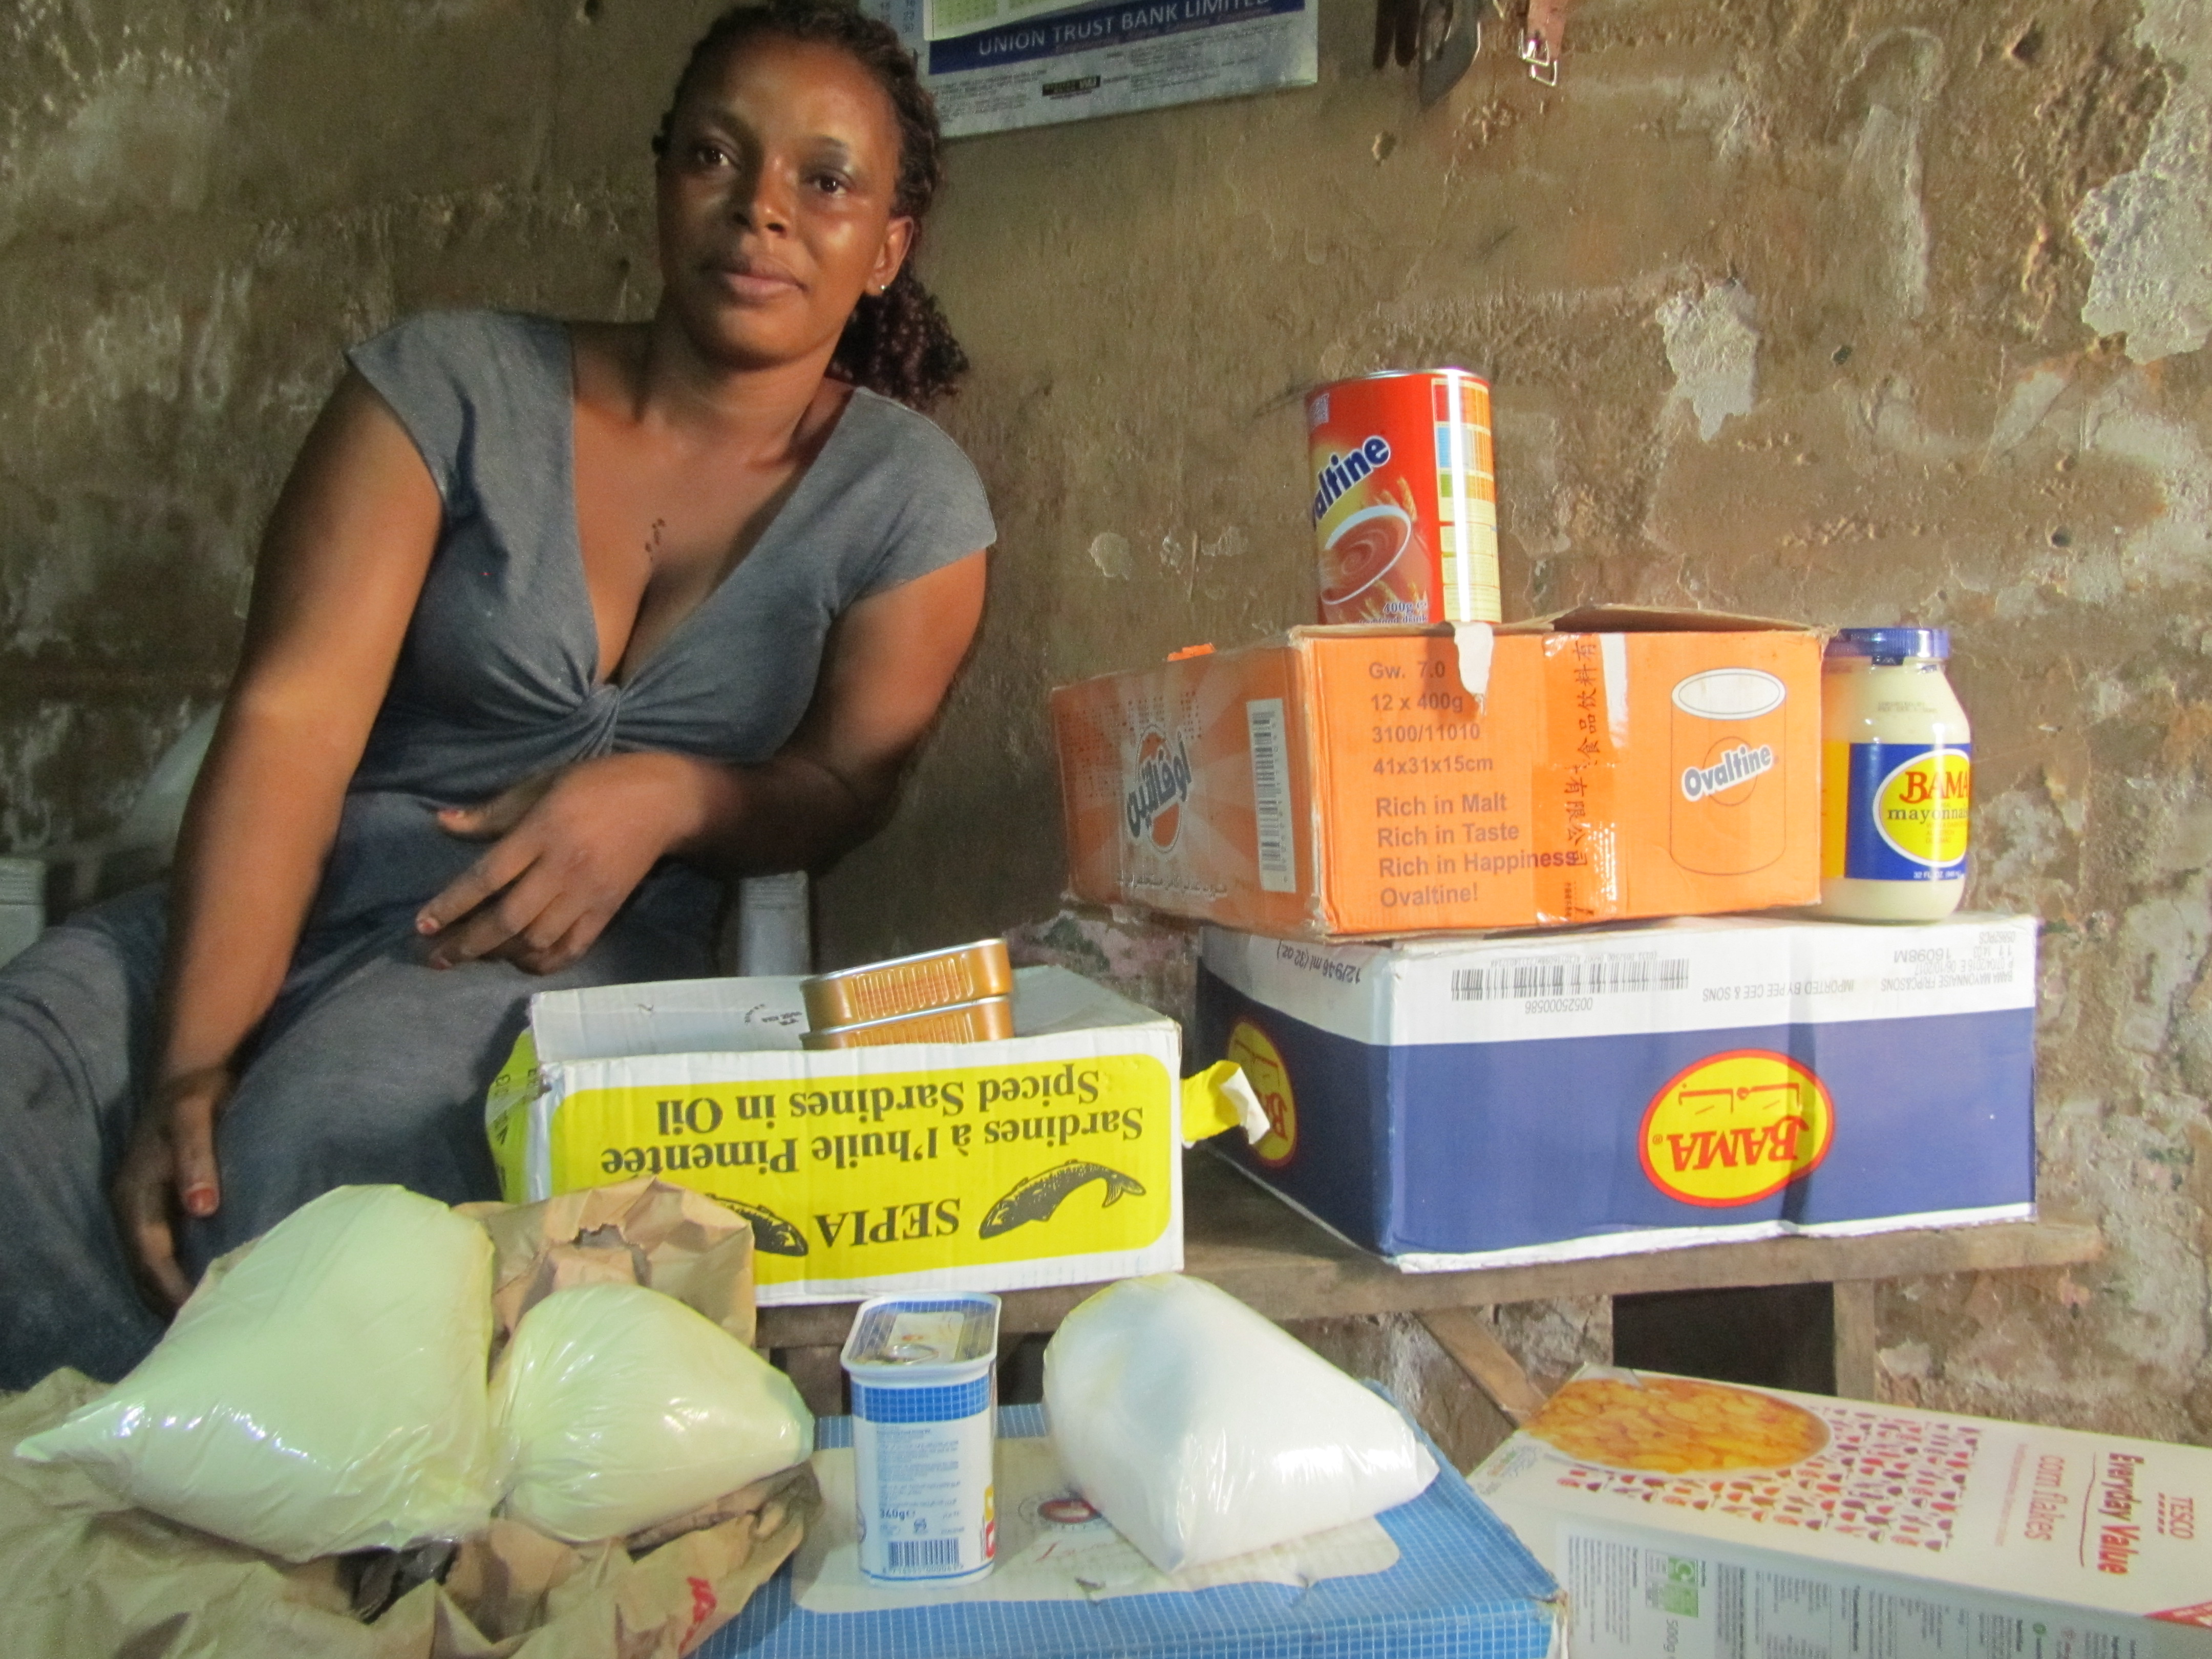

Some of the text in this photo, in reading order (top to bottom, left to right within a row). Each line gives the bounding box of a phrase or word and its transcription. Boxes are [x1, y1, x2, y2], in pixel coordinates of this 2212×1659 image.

[979, 29, 1045, 56] UNION
[1053, 16, 1114, 44] TRUST
[1121, 6, 1178, 31] BANK
[1368, 661, 1445, 680] Gw. 7.0
[1371, 693, 1463, 714] 12 x 400g
[1372, 722, 1481, 745] 3100/11010
[1373, 755, 1494, 776] 41x31x15cm
[1684, 746, 1772, 799] Ovaltine
[1376, 792, 1507, 818] Rich in Malt
[1377, 822, 1520, 848] Rich in Taste
[1379, 848, 1578, 878] Rich in Happiness
[1380, 883, 1478, 908] Ovaltine!
[1894, 948, 1951, 964] 16098M
[1703, 979, 1854, 1002] IMPORTED BY PEE CEE & SONS
[1938, 973, 1991, 988] MAYONNAISE
[1993, 970, 2013, 983] BAMA
[1525, 997, 1593, 1014] 00525000586
[656, 1064, 1099, 1135] Spiced Sardines in Oil
[951, 1124, 972, 1156] à
[984, 1107, 1143, 1147] Sardines
[811, 1127, 938, 1171] l'huile
[1667, 1115, 1810, 1172] BAMA
[813, 1198, 961, 1248] SEPIA
[2025, 1456, 2069, 1541] corn flakes
[2098, 1452, 2144, 1574] Everyday Value
[2169, 1497, 2195, 1539] TESCO
[1663, 1619, 1679, 1652] 500g
